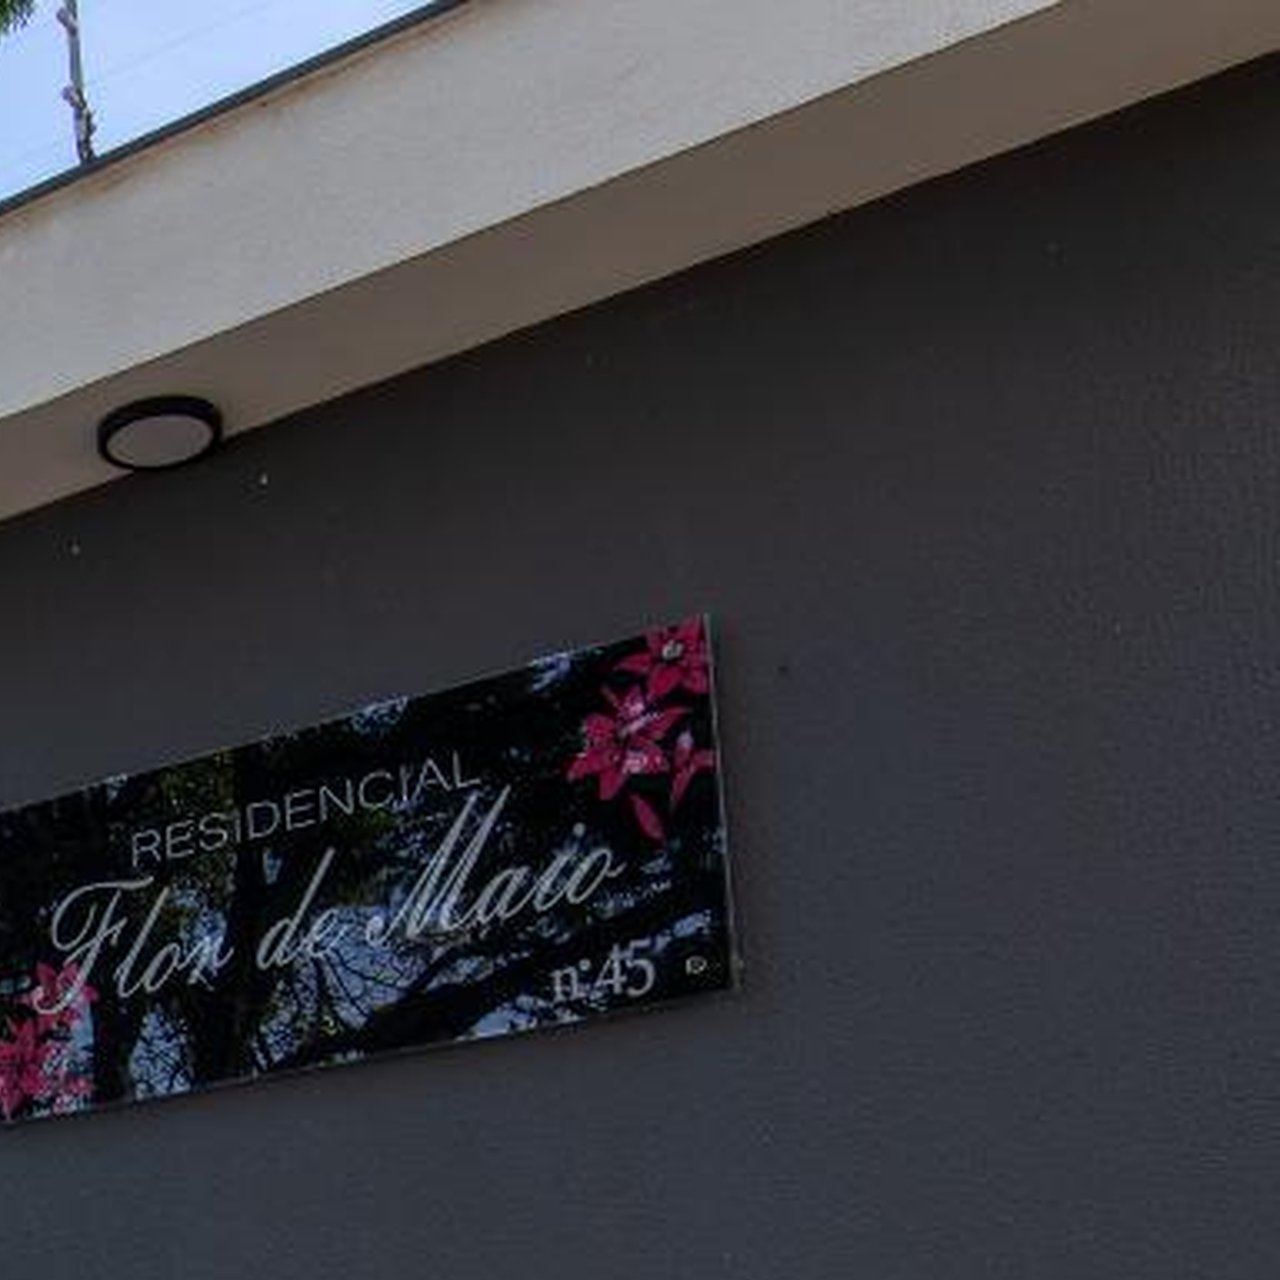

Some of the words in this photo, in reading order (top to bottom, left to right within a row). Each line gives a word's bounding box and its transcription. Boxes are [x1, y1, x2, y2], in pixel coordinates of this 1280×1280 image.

[132, 751, 482, 868] RESIDENCIAL
[33, 876, 236, 1013] Flor
[255, 847, 345, 971] de
[366, 785, 628, 943] Maio
